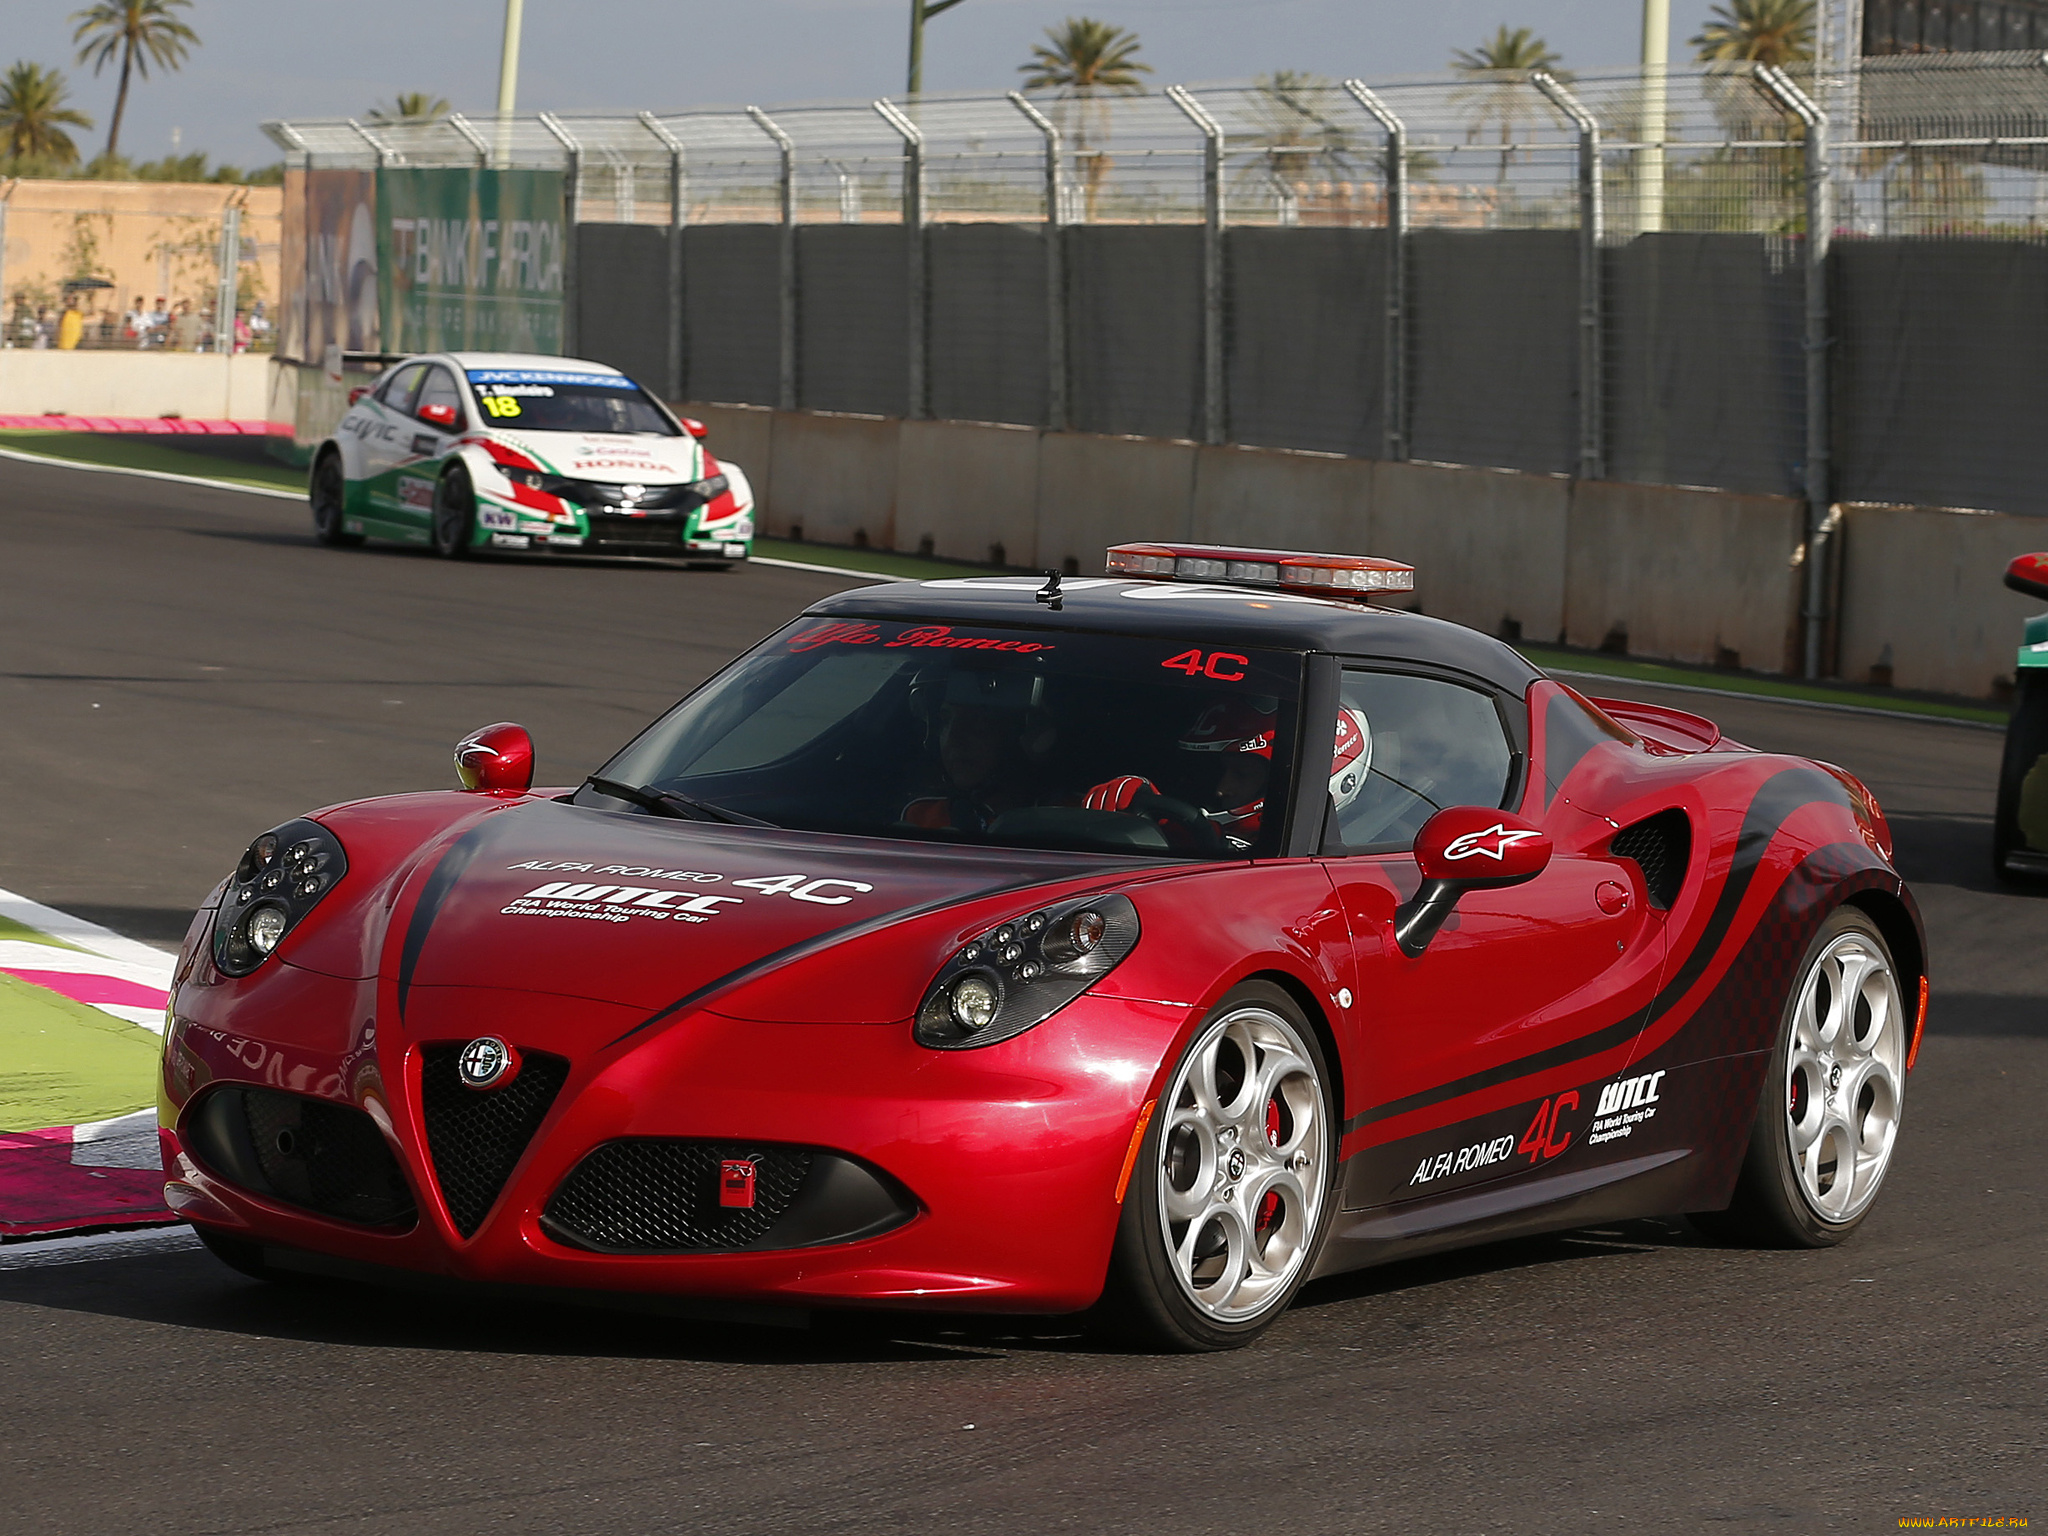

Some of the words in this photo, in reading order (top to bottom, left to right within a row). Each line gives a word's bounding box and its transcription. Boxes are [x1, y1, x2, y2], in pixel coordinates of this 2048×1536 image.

[482, 396, 523, 418] 18
[573, 459, 678, 474] HONDA
[786, 622, 881, 653] Alfa
[883, 625, 1056, 653] Romeo
[1161, 649, 1249, 682] 4C
[506, 860, 594, 873] ALFA
[593, 865, 724, 883] ROMEO
[731, 874, 875, 906] 4C
[510, 898, 541, 906] FIA
[545, 900, 601, 911] World
[603, 904, 670, 919] Touring
[673, 912, 709, 924] Car
[523, 881, 744, 915] WTCC
[500, 906, 630, 923] Championship
[1594, 1069, 1666, 1117] WTCC
[1592, 1120, 1603, 1132] FIA
[1603, 1115, 1622, 1130] World
[1622, 1110, 1645, 1123] Touring
[1644, 1107, 1656, 1119] Car
[1409, 1151, 1453, 1186] ALFA
[1452, 1134, 1514, 1175] ROMEO
[1517, 1090, 1580, 1164] 4C
[1588, 1124, 1632, 1146] Championship
